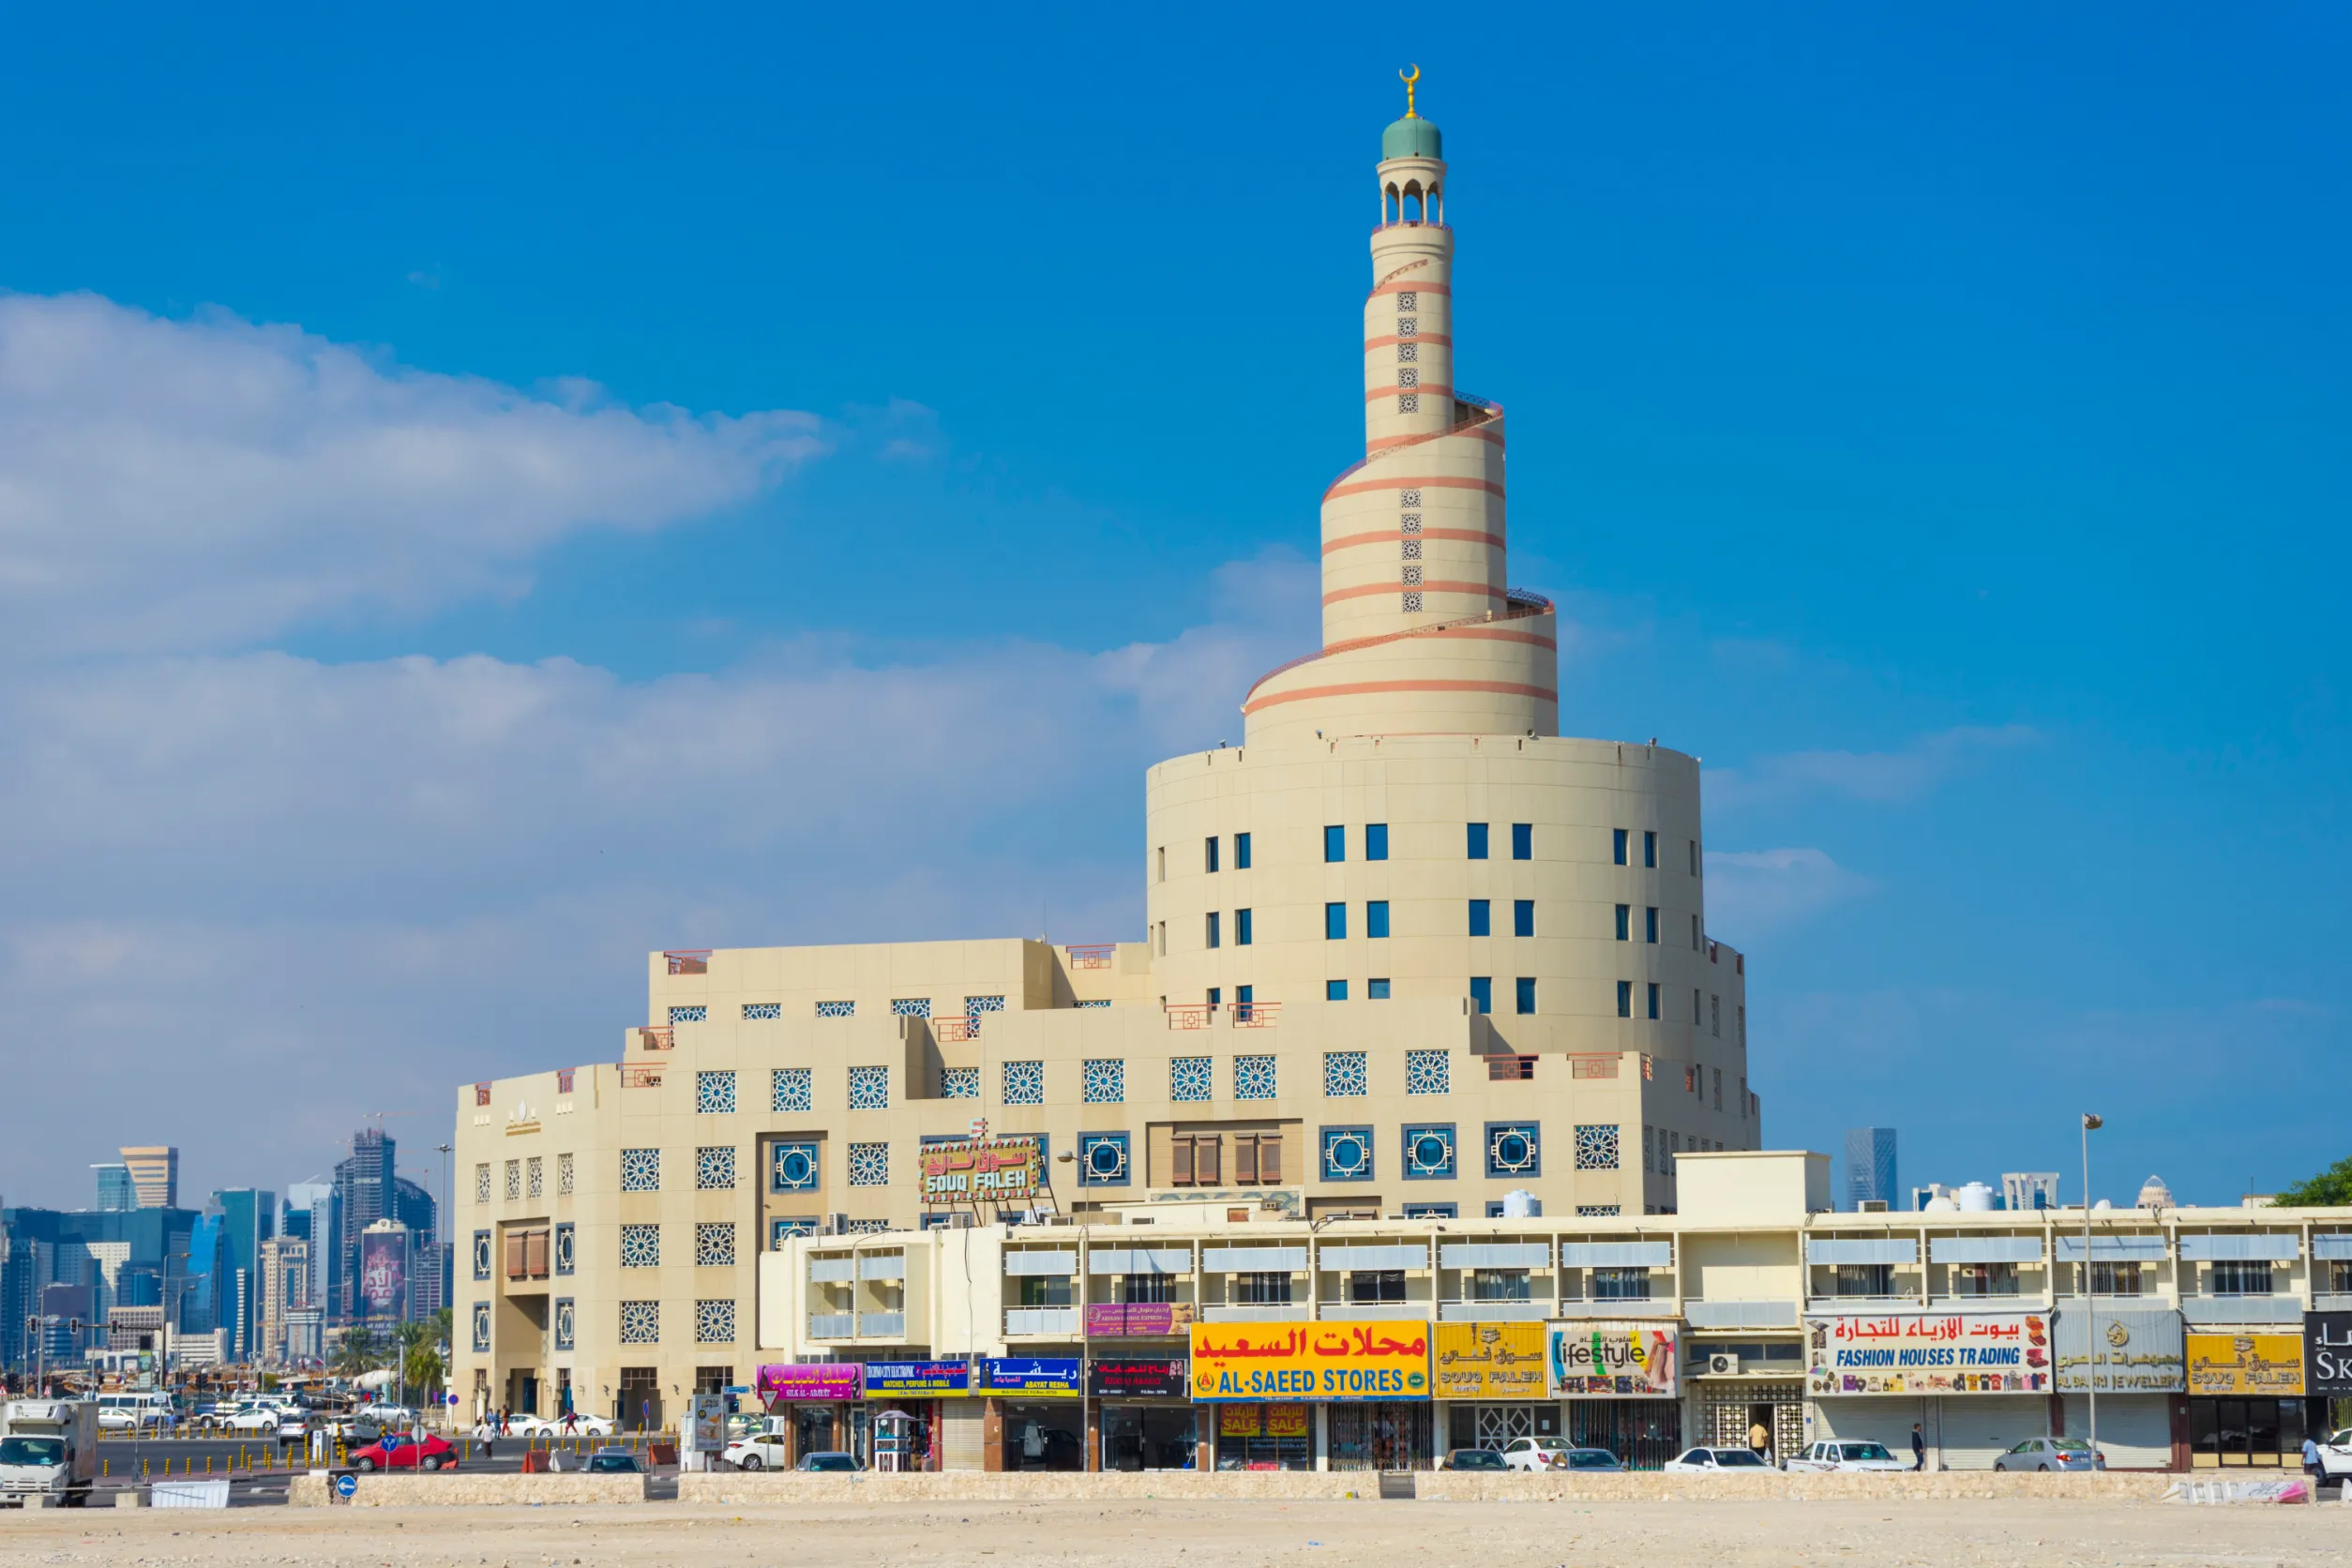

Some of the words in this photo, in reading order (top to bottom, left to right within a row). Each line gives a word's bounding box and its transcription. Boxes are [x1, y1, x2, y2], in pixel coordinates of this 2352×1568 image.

[976, 1149, 1026, 1172] سوق
[926, 1174, 967, 1193] SOUQ
[973, 1169, 1026, 1190] FALEH
[1835, 1316, 1900, 1342] للتجارة
[1969, 1322, 2019, 1340] بيوت
[1194, 1327, 1306, 1368] السعيد
[1314, 1325, 1426, 1358] محلات
[1494, 1348, 1543, 1364] سوق
[1555, 1338, 1646, 1369] lifestyle
[1836, 1349, 1895, 1367] FASHION
[1898, 1348, 1954, 1366] HOUSES
[1959, 1347, 2021, 1365] TRADING
[2247, 1353, 2300, 1372] سوق
[992, 1361, 1078, 1380] ريشة
[1440, 1371, 1483, 1383] SOUQ
[1488, 1370, 1543, 1383] FALEH
[2191, 1372, 2236, 1385] SOUQ
[2244, 1371, 2300, 1385] FALEH
[905, 1380, 927, 1388] PERFUME
[932, 1380, 950, 1388] MOBILE
[1024, 1380, 1048, 1389] ABAYAT
[1048, 1380, 1069, 1389] RESHA
[1132, 1376, 1163, 1385] ABAYAT
[1323, 1368, 1404, 1393] STORES
[786, 1389, 798, 1397] SILK
[1223, 1418, 1258, 1431] SALE
[1269, 1418, 1304, 1431] SALE
